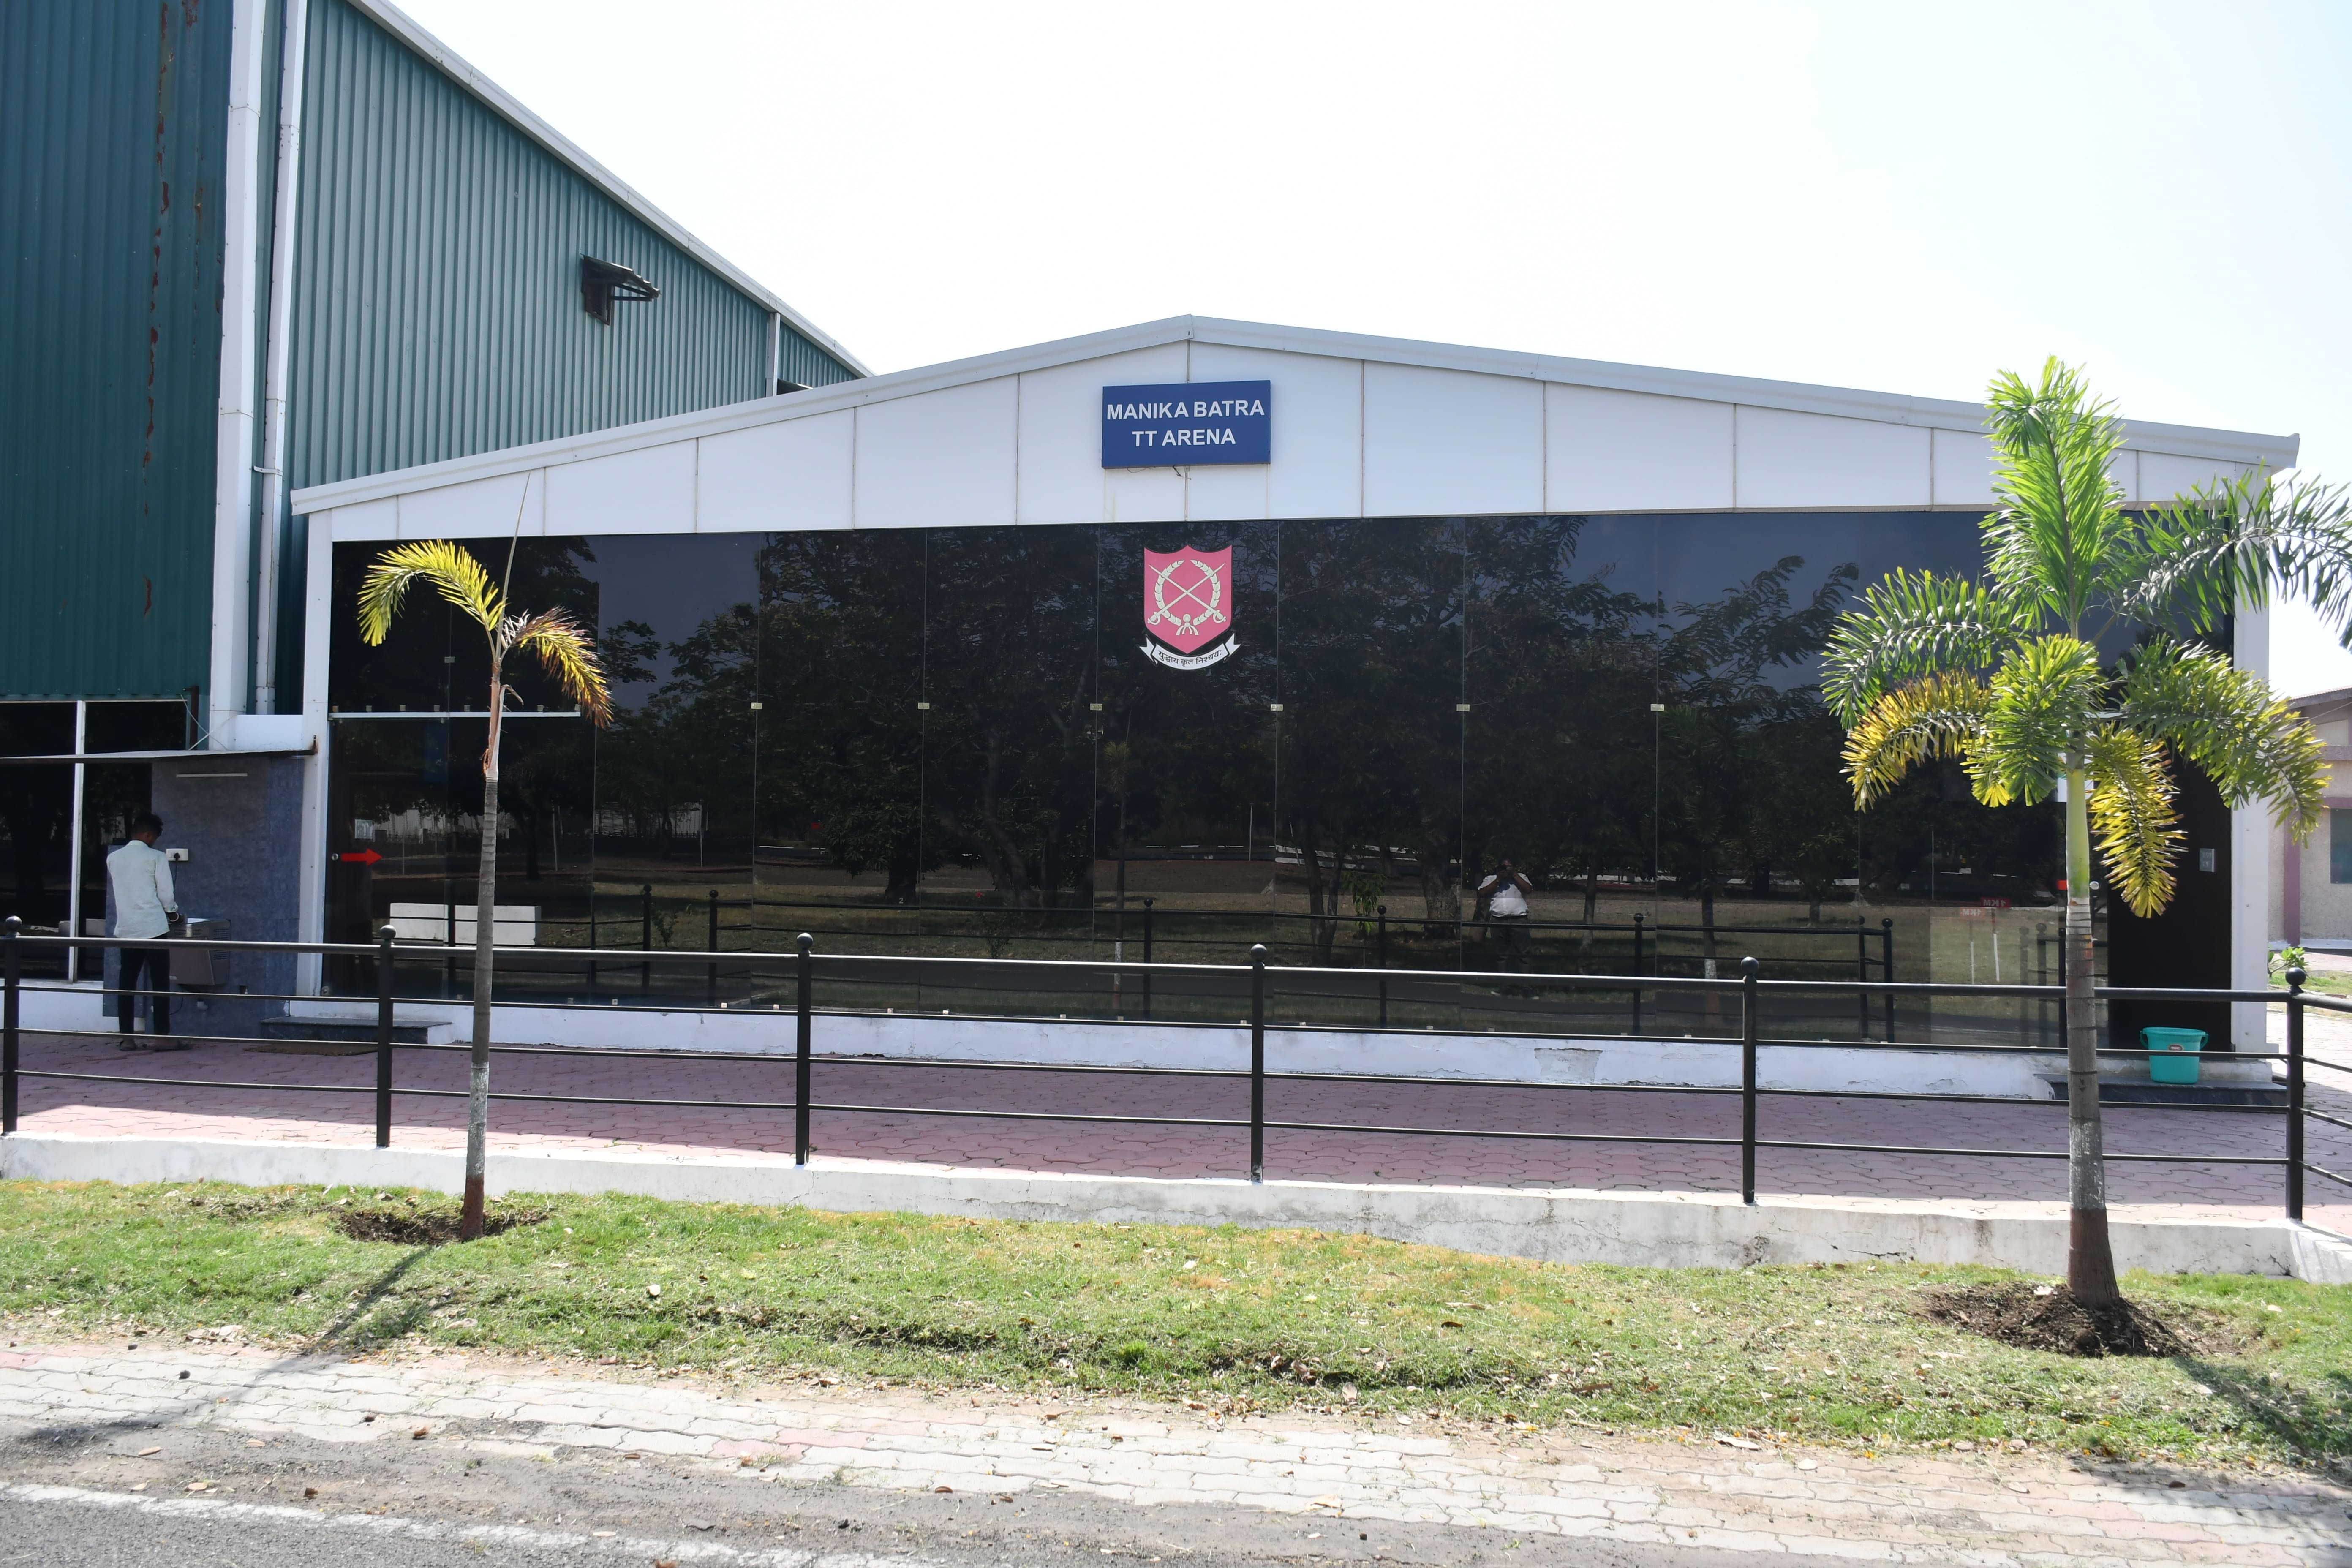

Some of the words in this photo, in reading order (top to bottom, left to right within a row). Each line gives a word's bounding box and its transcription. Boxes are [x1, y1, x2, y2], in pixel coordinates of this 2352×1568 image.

[1107, 402, 1189, 420] MANIKA
[1193, 400, 1265, 417] BATRA
[1132, 430, 1157, 447] TT
[1162, 428, 1236, 446] ARENA
[1158, 650, 1179, 664] युद्धाय
[1180, 659, 1194, 667] कृत
